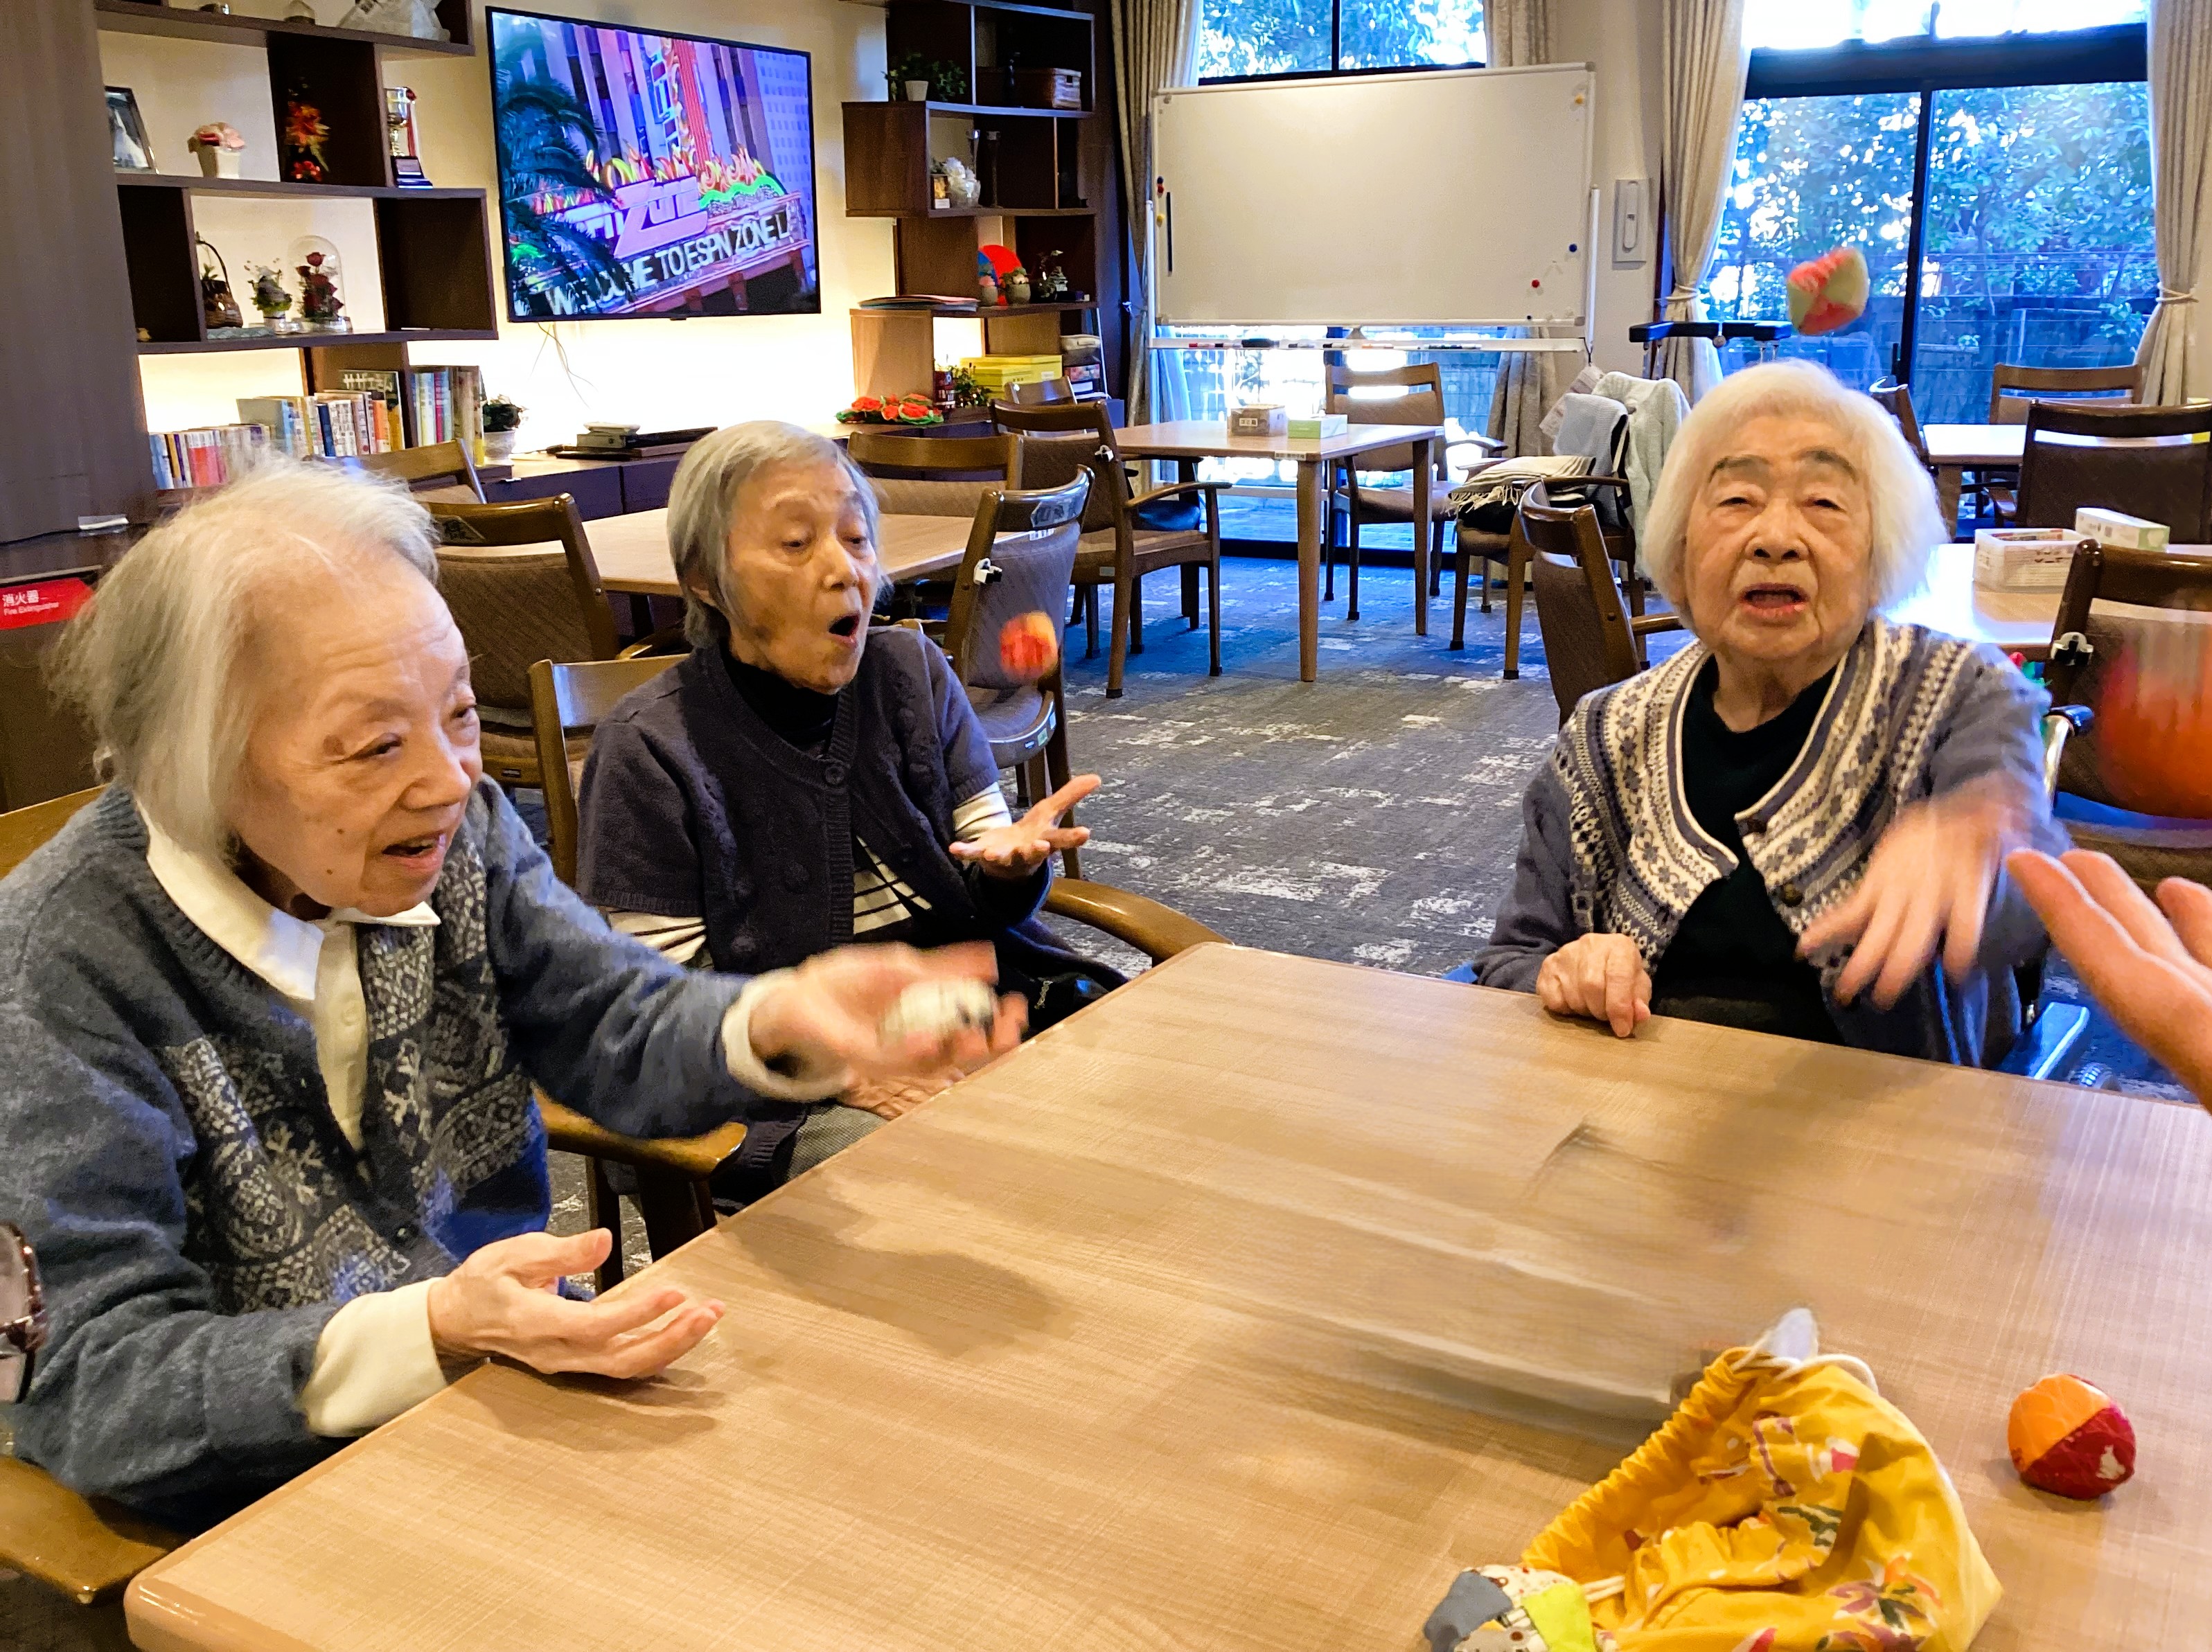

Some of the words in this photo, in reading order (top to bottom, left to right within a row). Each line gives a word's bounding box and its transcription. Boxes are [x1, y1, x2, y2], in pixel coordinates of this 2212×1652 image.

[655, 246, 686, 279] TO
[682, 231, 733, 271] ESPN
[731, 215, 777, 254] ZONE
[2, 589, 39, 607] 消火器
